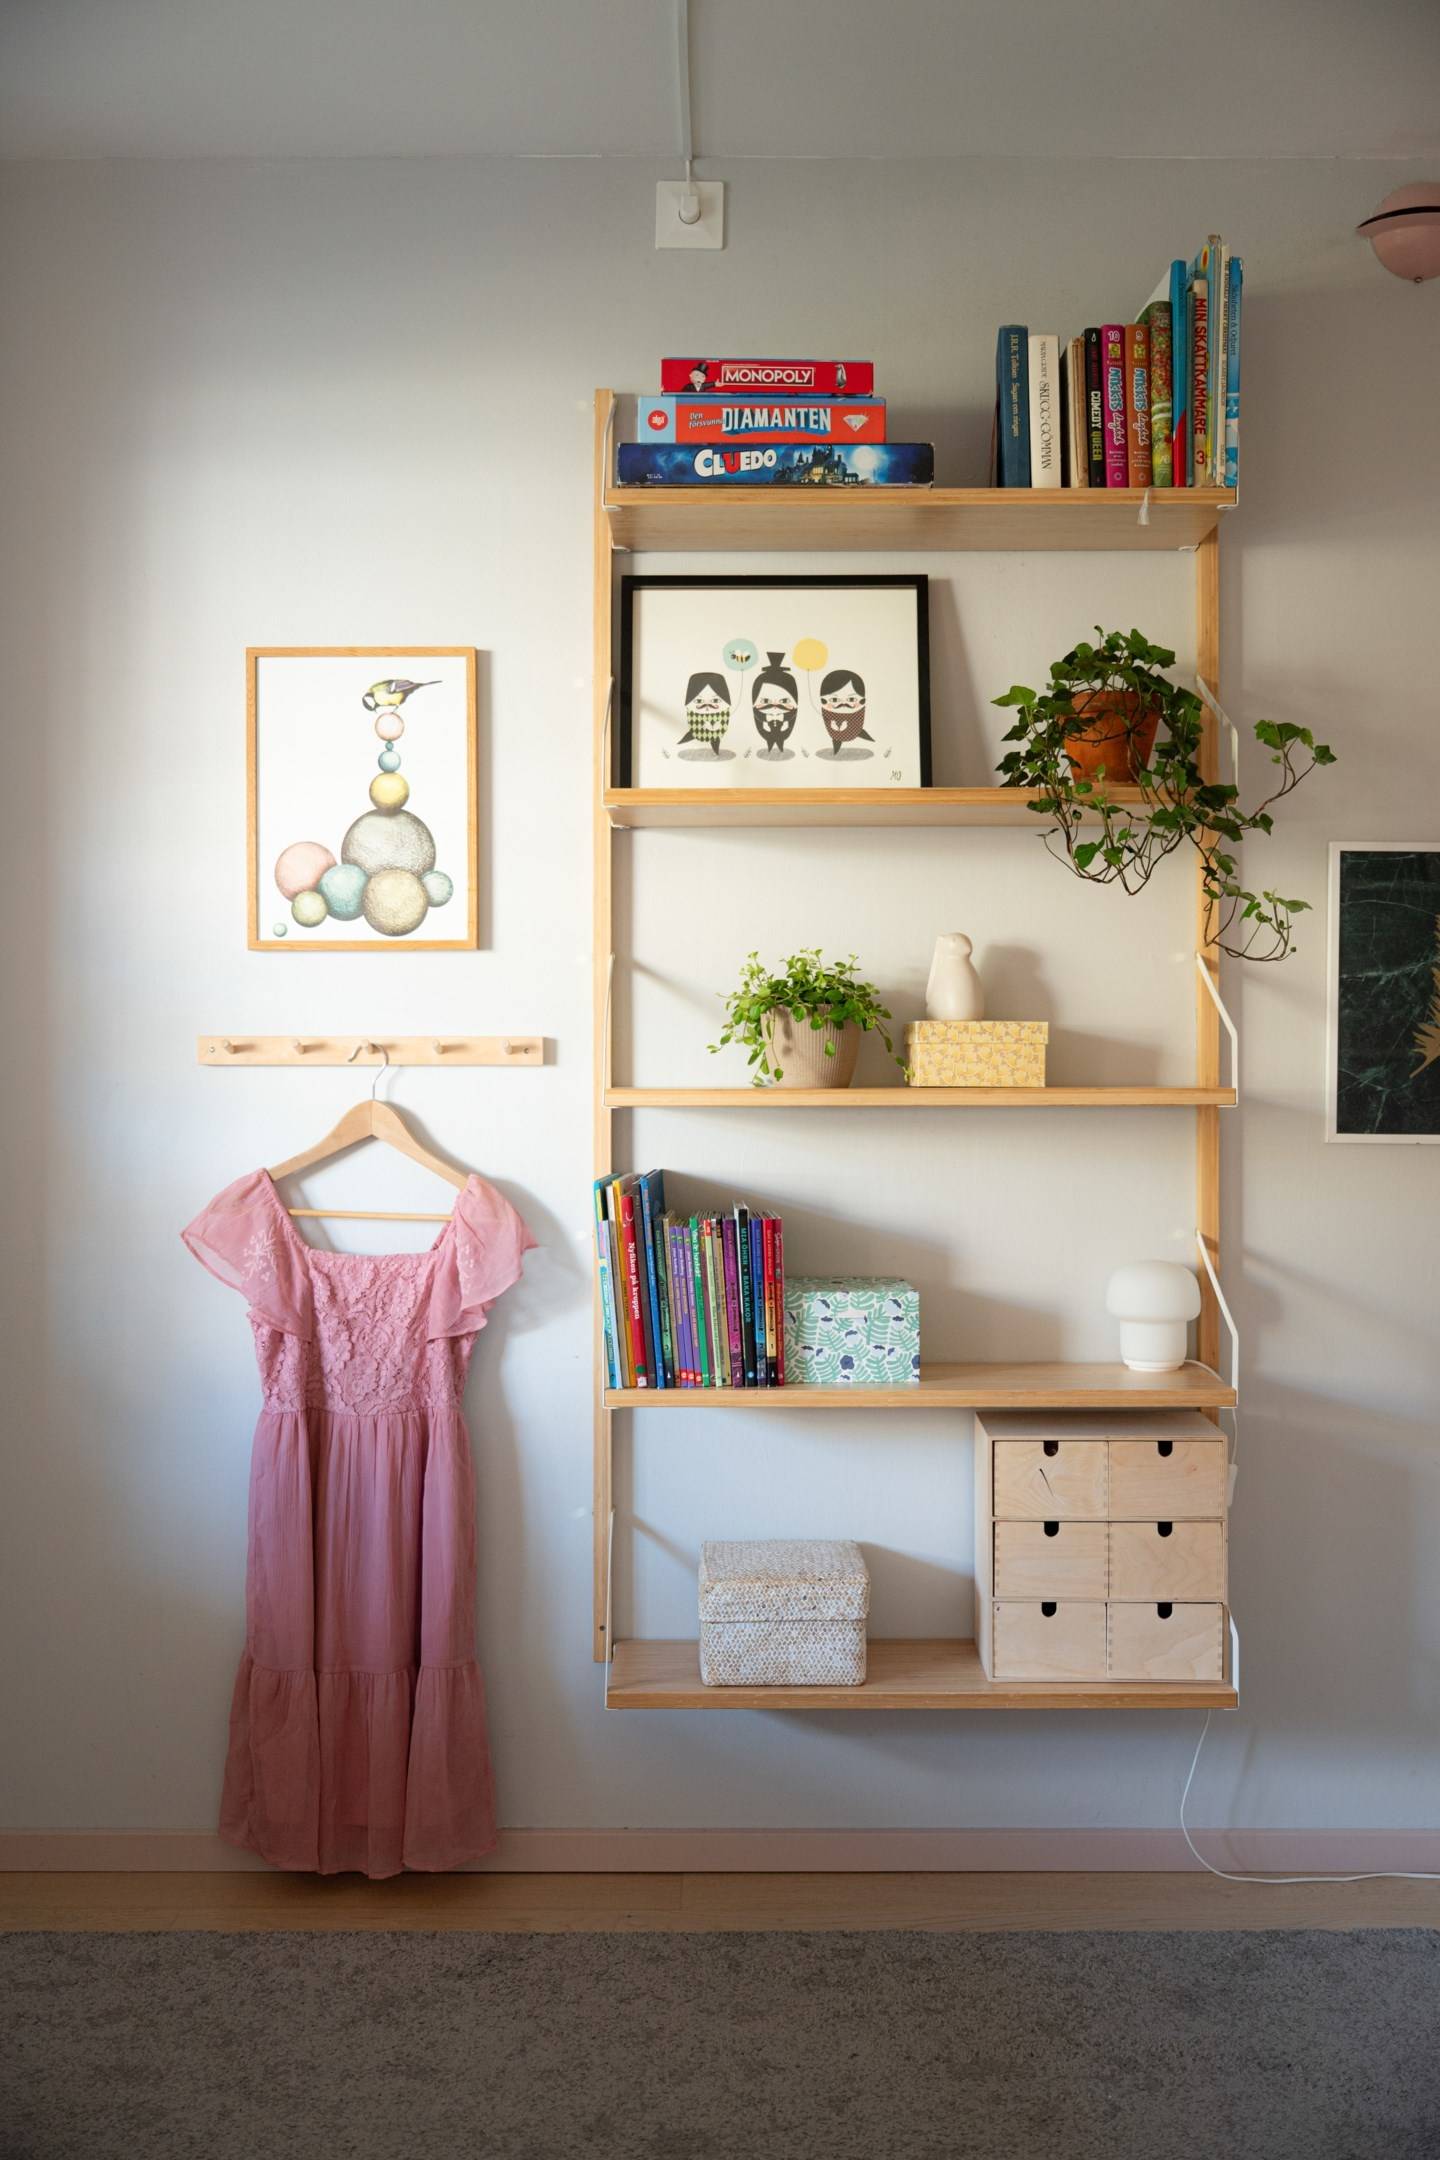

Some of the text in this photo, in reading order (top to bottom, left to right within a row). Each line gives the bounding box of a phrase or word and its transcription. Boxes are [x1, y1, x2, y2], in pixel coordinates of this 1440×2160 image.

[1108, 330, 1120, 342] 10
[725, 368, 811, 383] MONOPOLY
[1194, 298, 1207, 435] MIN SKATTKAMMARE
[722, 407, 831, 433] DIAMANTEN
[1091, 391, 1101, 428] COMEDY
[1092, 431, 1102, 461] QUEEN
[1195, 450, 1205, 465] 3
[694, 449, 777, 478] CLUEDO
[627, 1242, 640, 1320] Nyfiken på kroppen
